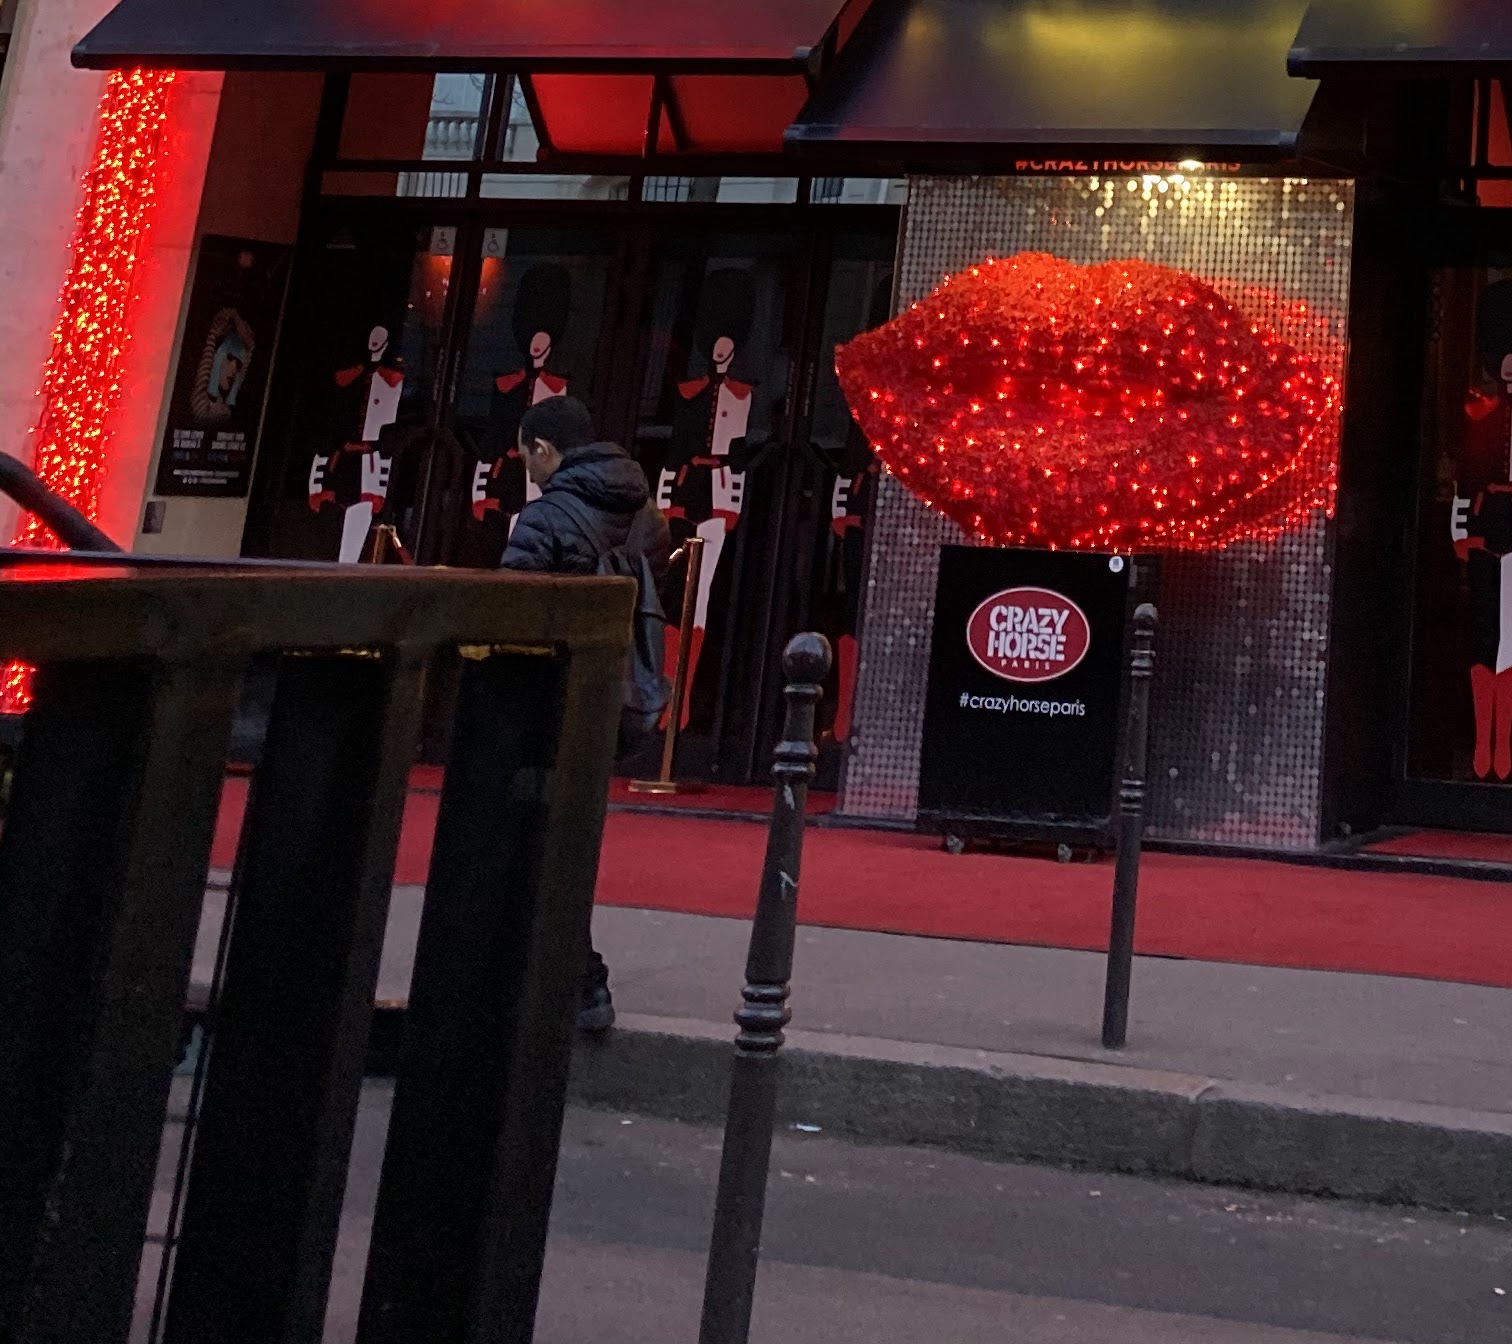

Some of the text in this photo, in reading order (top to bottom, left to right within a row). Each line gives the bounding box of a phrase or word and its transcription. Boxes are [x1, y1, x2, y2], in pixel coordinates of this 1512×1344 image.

[1015, 157, 1241, 171] #CRAZYHORSERIS
[989, 604, 1070, 635] CRAZY
[987, 630, 1067, 662] HORSE
[1001, 658, 1050, 670] PARIS
[959, 691, 1086, 718] #crazyhorseparis
